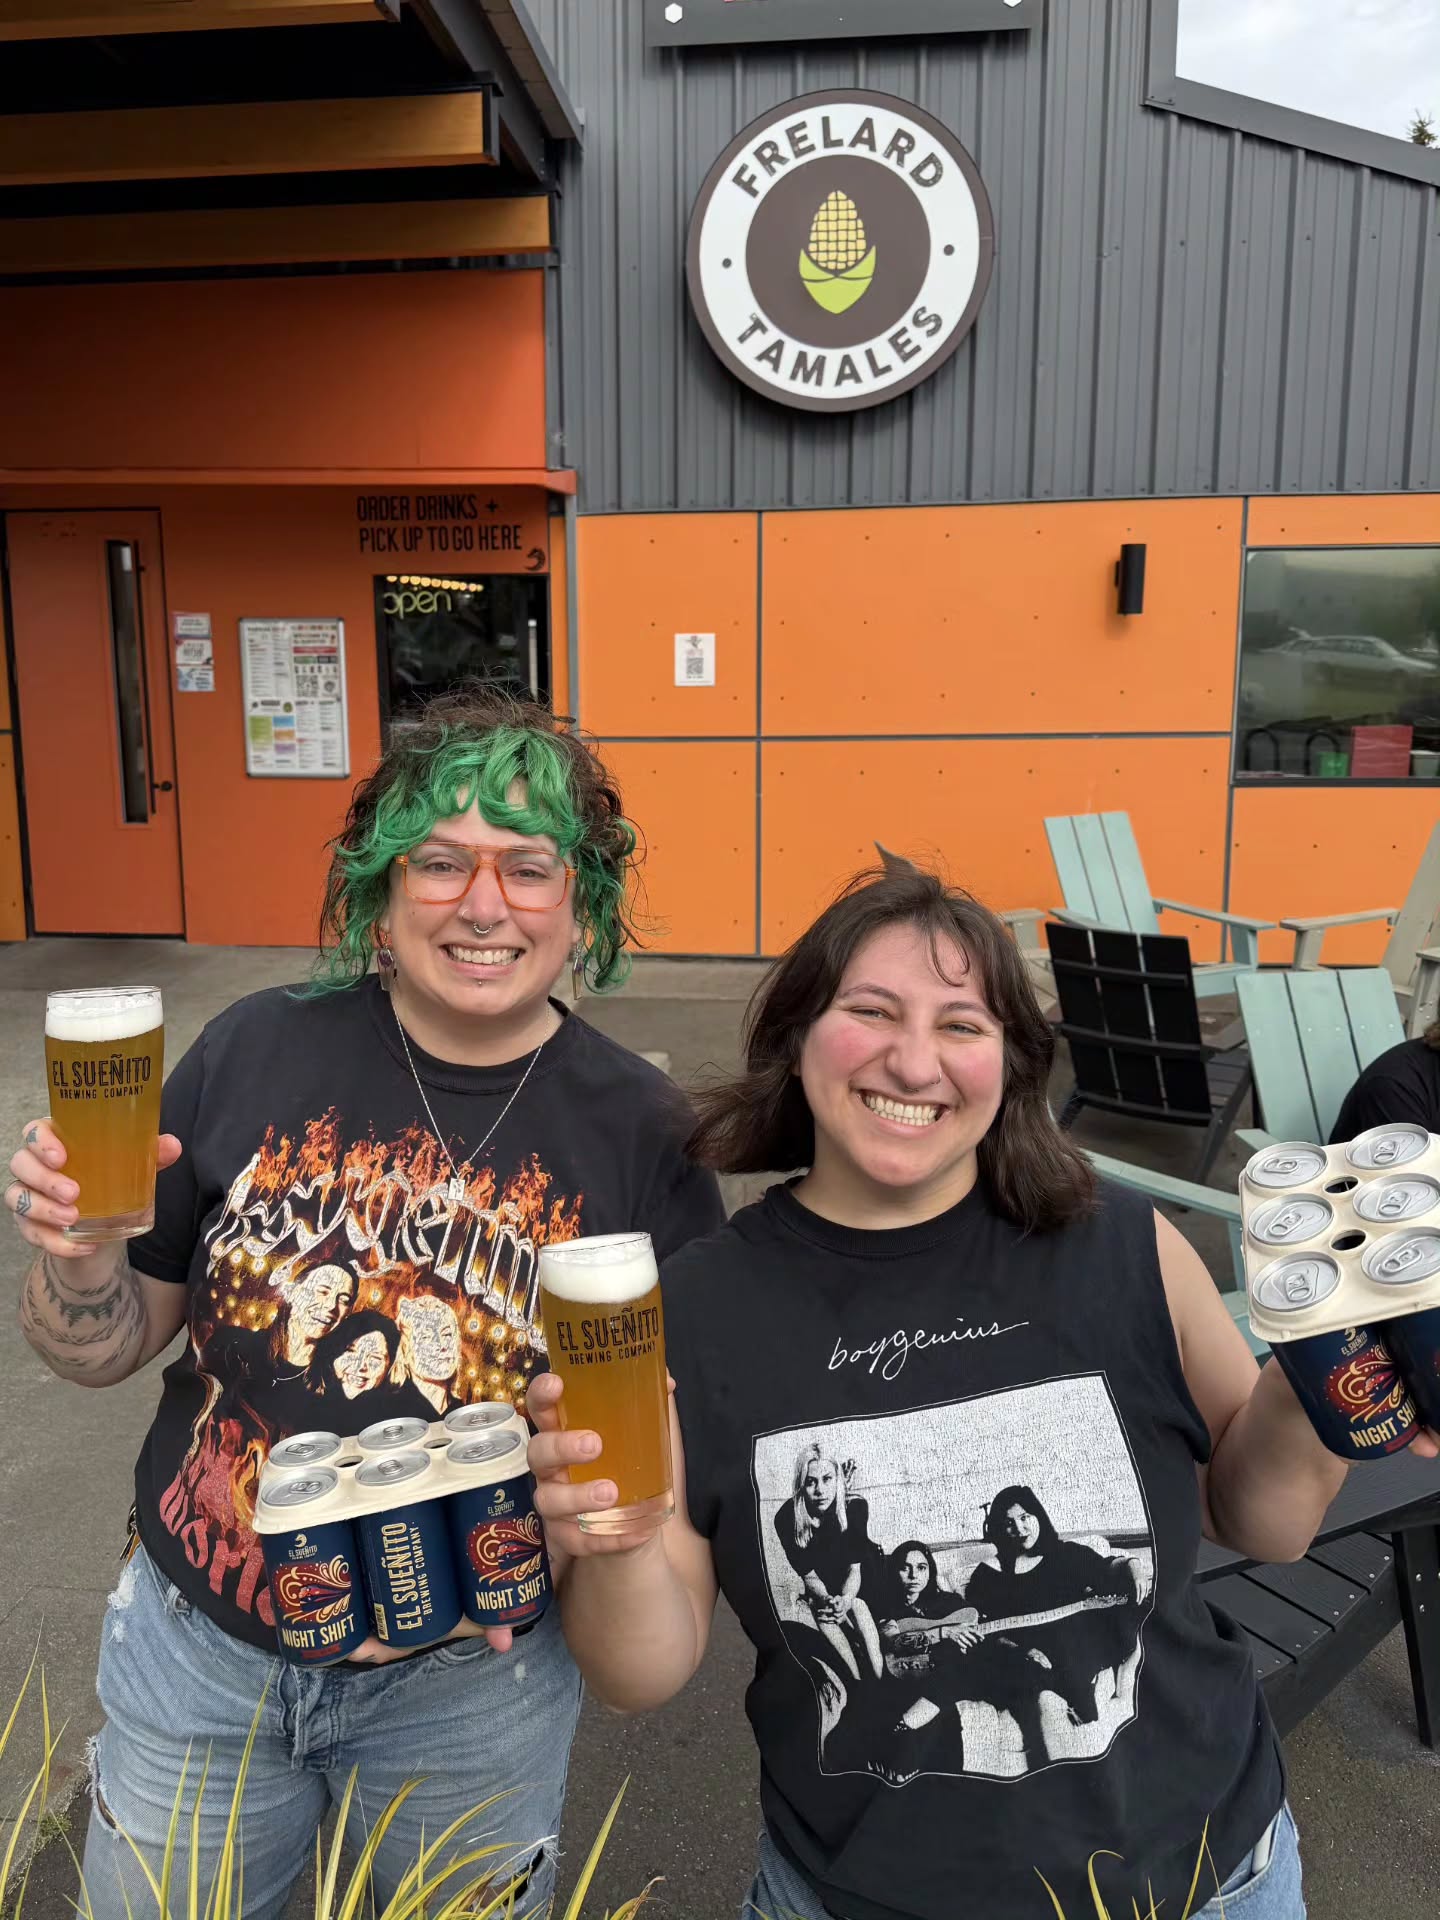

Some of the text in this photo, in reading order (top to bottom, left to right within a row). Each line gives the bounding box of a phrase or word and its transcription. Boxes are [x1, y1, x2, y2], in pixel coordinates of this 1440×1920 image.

[732, 115, 944, 198] FRELARD
[737, 306, 943, 387] TAMALES
[357, 496, 410, 521] ORDER
[416, 494, 478, 520] DRINKS
[360, 524, 522, 552] PICK UP TO GO HERE
[53, 1054, 151, 1087] EL SUEÑITO
[60, 1085, 144, 1099] BREWING COMPANY
[557, 1306, 659, 1351] EL SUEÑITO
[569, 1341, 656, 1365] BREWING COMPANY
[828, 1317, 1030, 1381] boygenius
[1348, 1416, 1398, 1448] NIGHT
[381, 1522, 423, 1630] EL SUEÑITO
[409, 1526, 433, 1616] BREWING COMPANY
[476, 1571, 546, 1610] NIGHT SHIFT
[282, 1613, 354, 1648] NIGHT SHIFT
